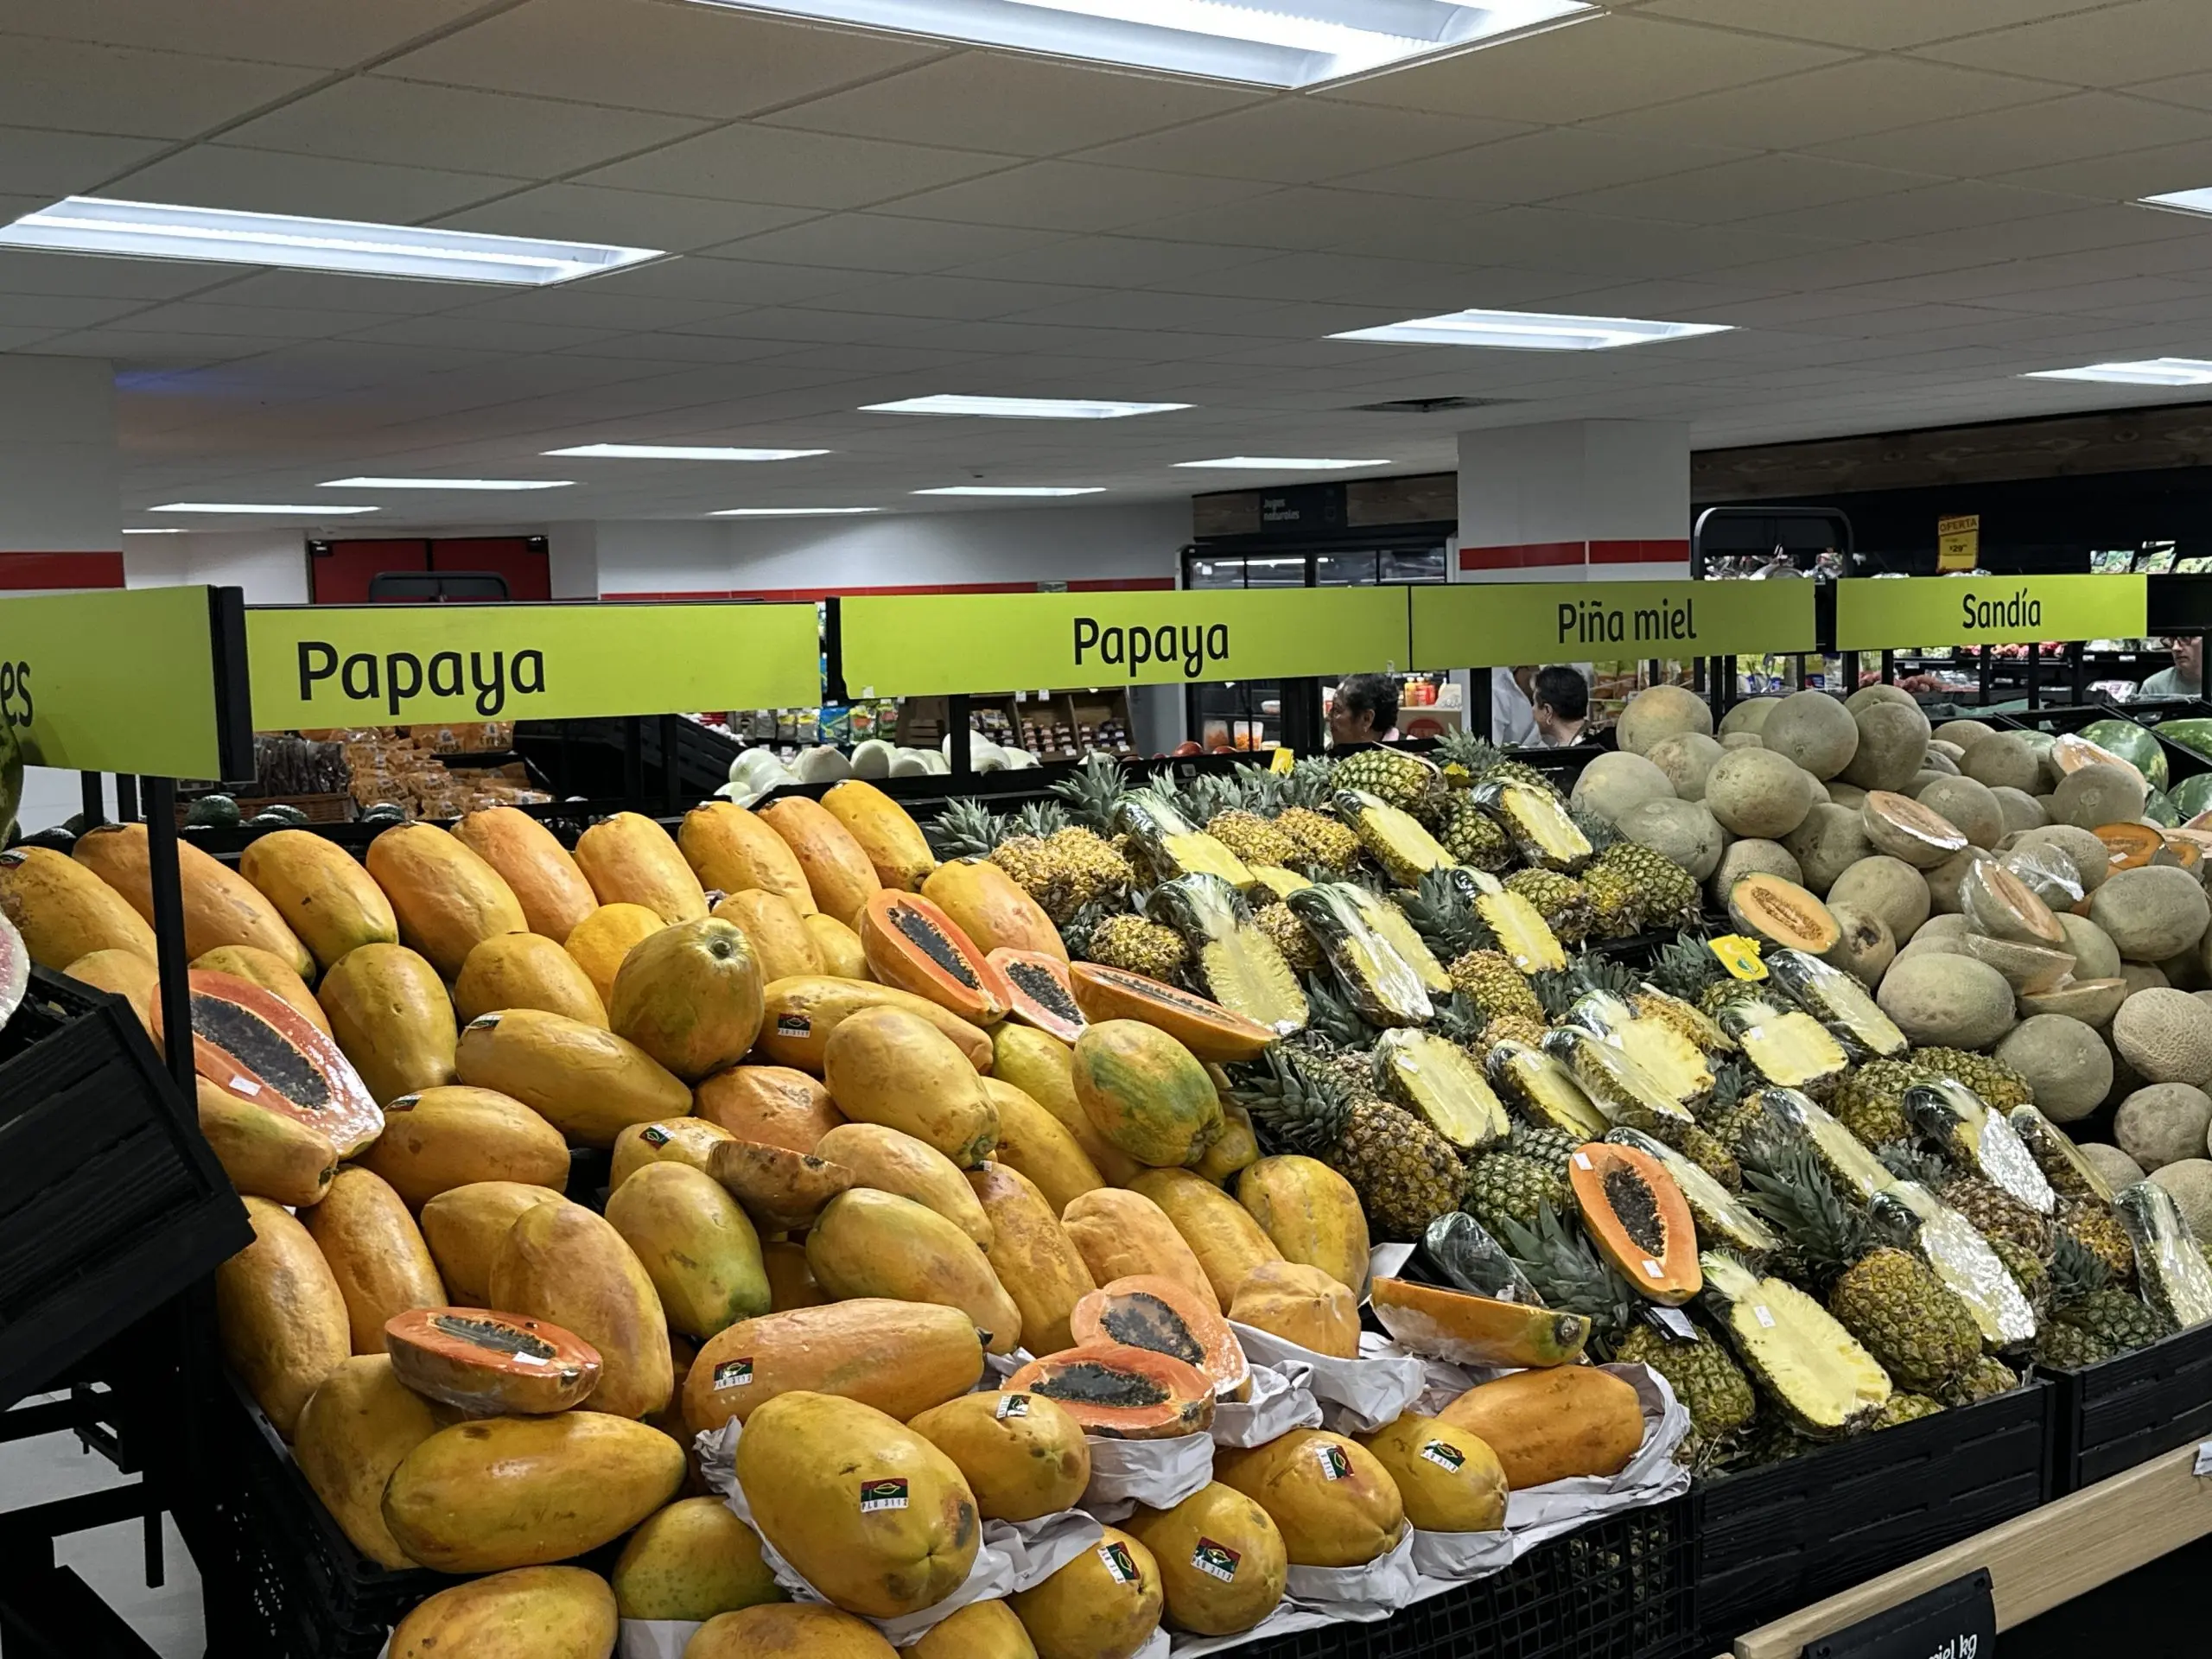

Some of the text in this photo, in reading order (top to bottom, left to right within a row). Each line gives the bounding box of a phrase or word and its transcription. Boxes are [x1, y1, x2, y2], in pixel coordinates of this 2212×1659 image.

[1940, 518, 1978, 532] OFERTA
[1962, 588, 2041, 629] Sandía
[1558, 598, 1697, 645] Piña miel
[1074, 617, 1230, 678] Papaya
[297, 640, 546, 717] Papaya
[861, 1498, 907, 1510] PLU 3112
[1109, 1564, 1124, 1581] 312
[1211, 1566, 1232, 1581] 3112
[1959, 1634, 1978, 1659] kg
